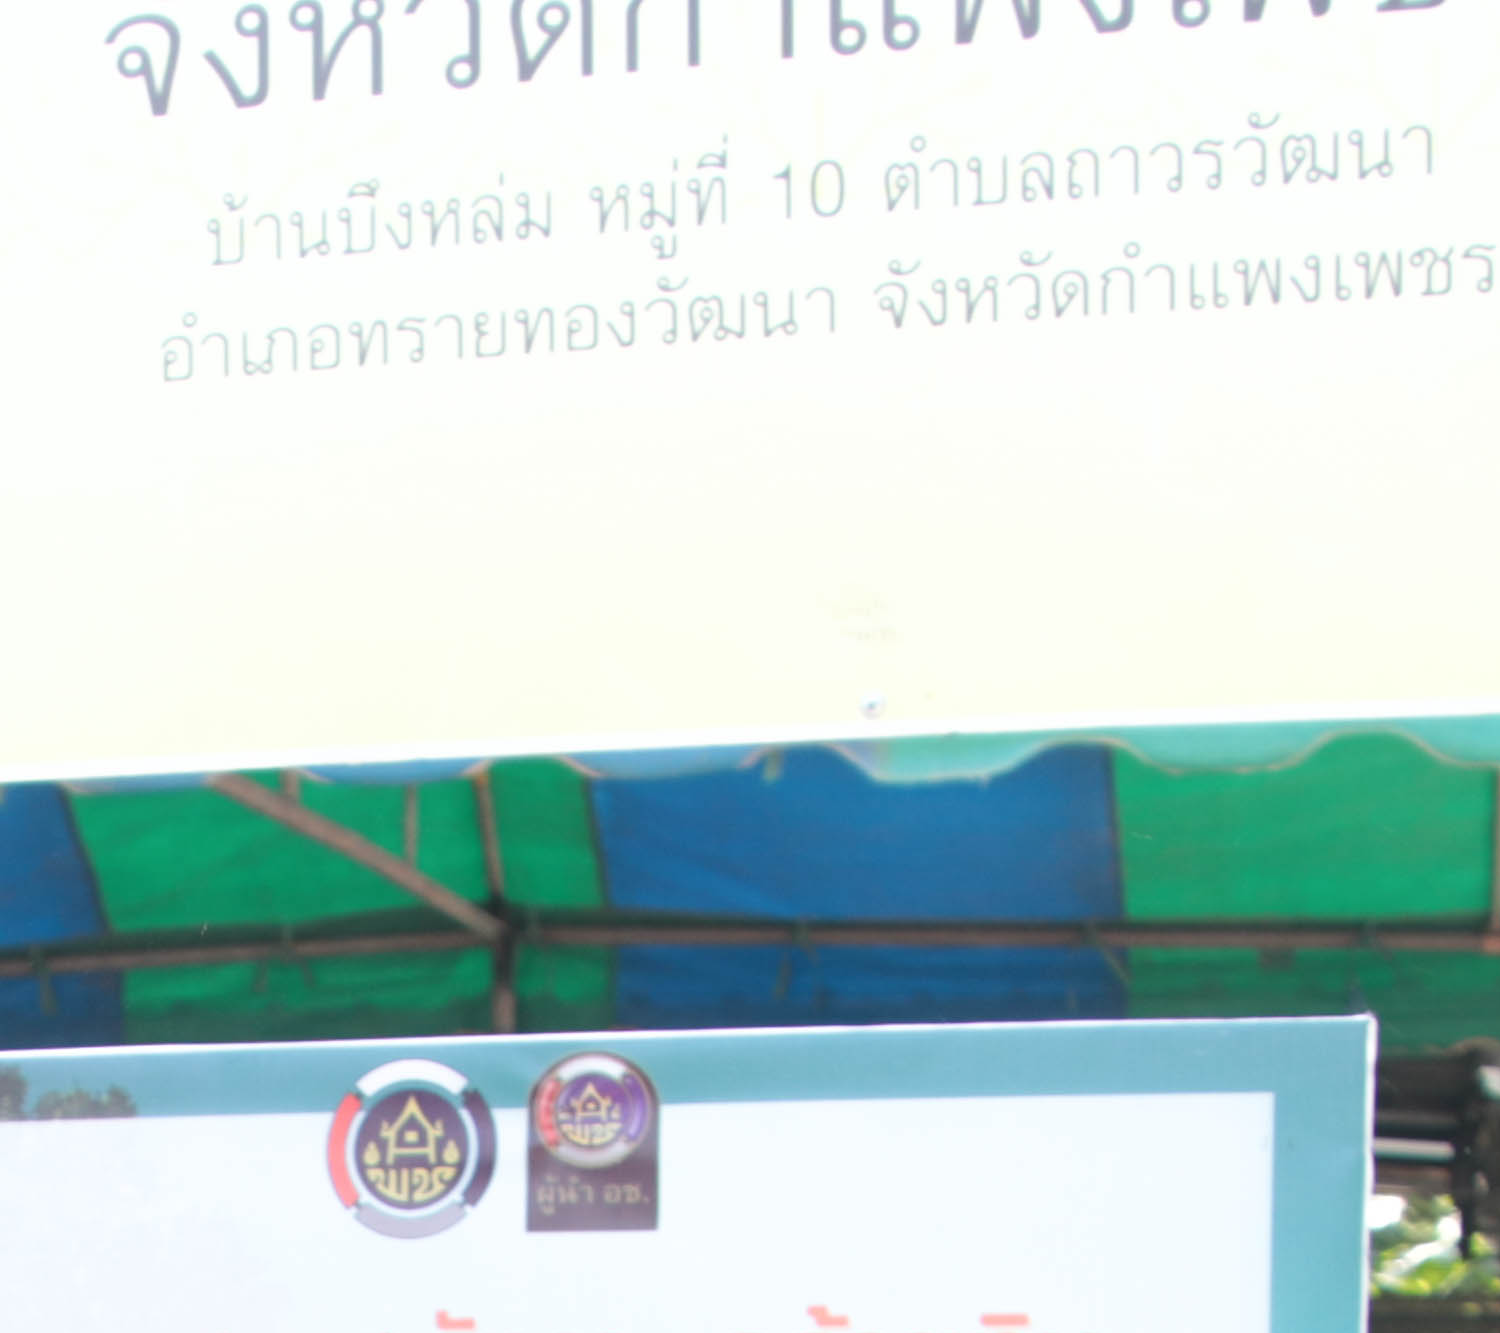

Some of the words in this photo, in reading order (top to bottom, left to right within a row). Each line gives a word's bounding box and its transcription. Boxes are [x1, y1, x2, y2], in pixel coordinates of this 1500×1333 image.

[207, 171, 553, 267] บ้านบึงหล่ม
[589, 133, 729, 261] หมู่ที่
[773, 160, 846, 219] 10
[883, 111, 1435, 213] ตำบลถาวรวัฒนา
[161, 275, 836, 383] อำเภอทรายทองวัฒนา
[873, 240, 1497, 329] จังหวัดกำแพงเพชร
